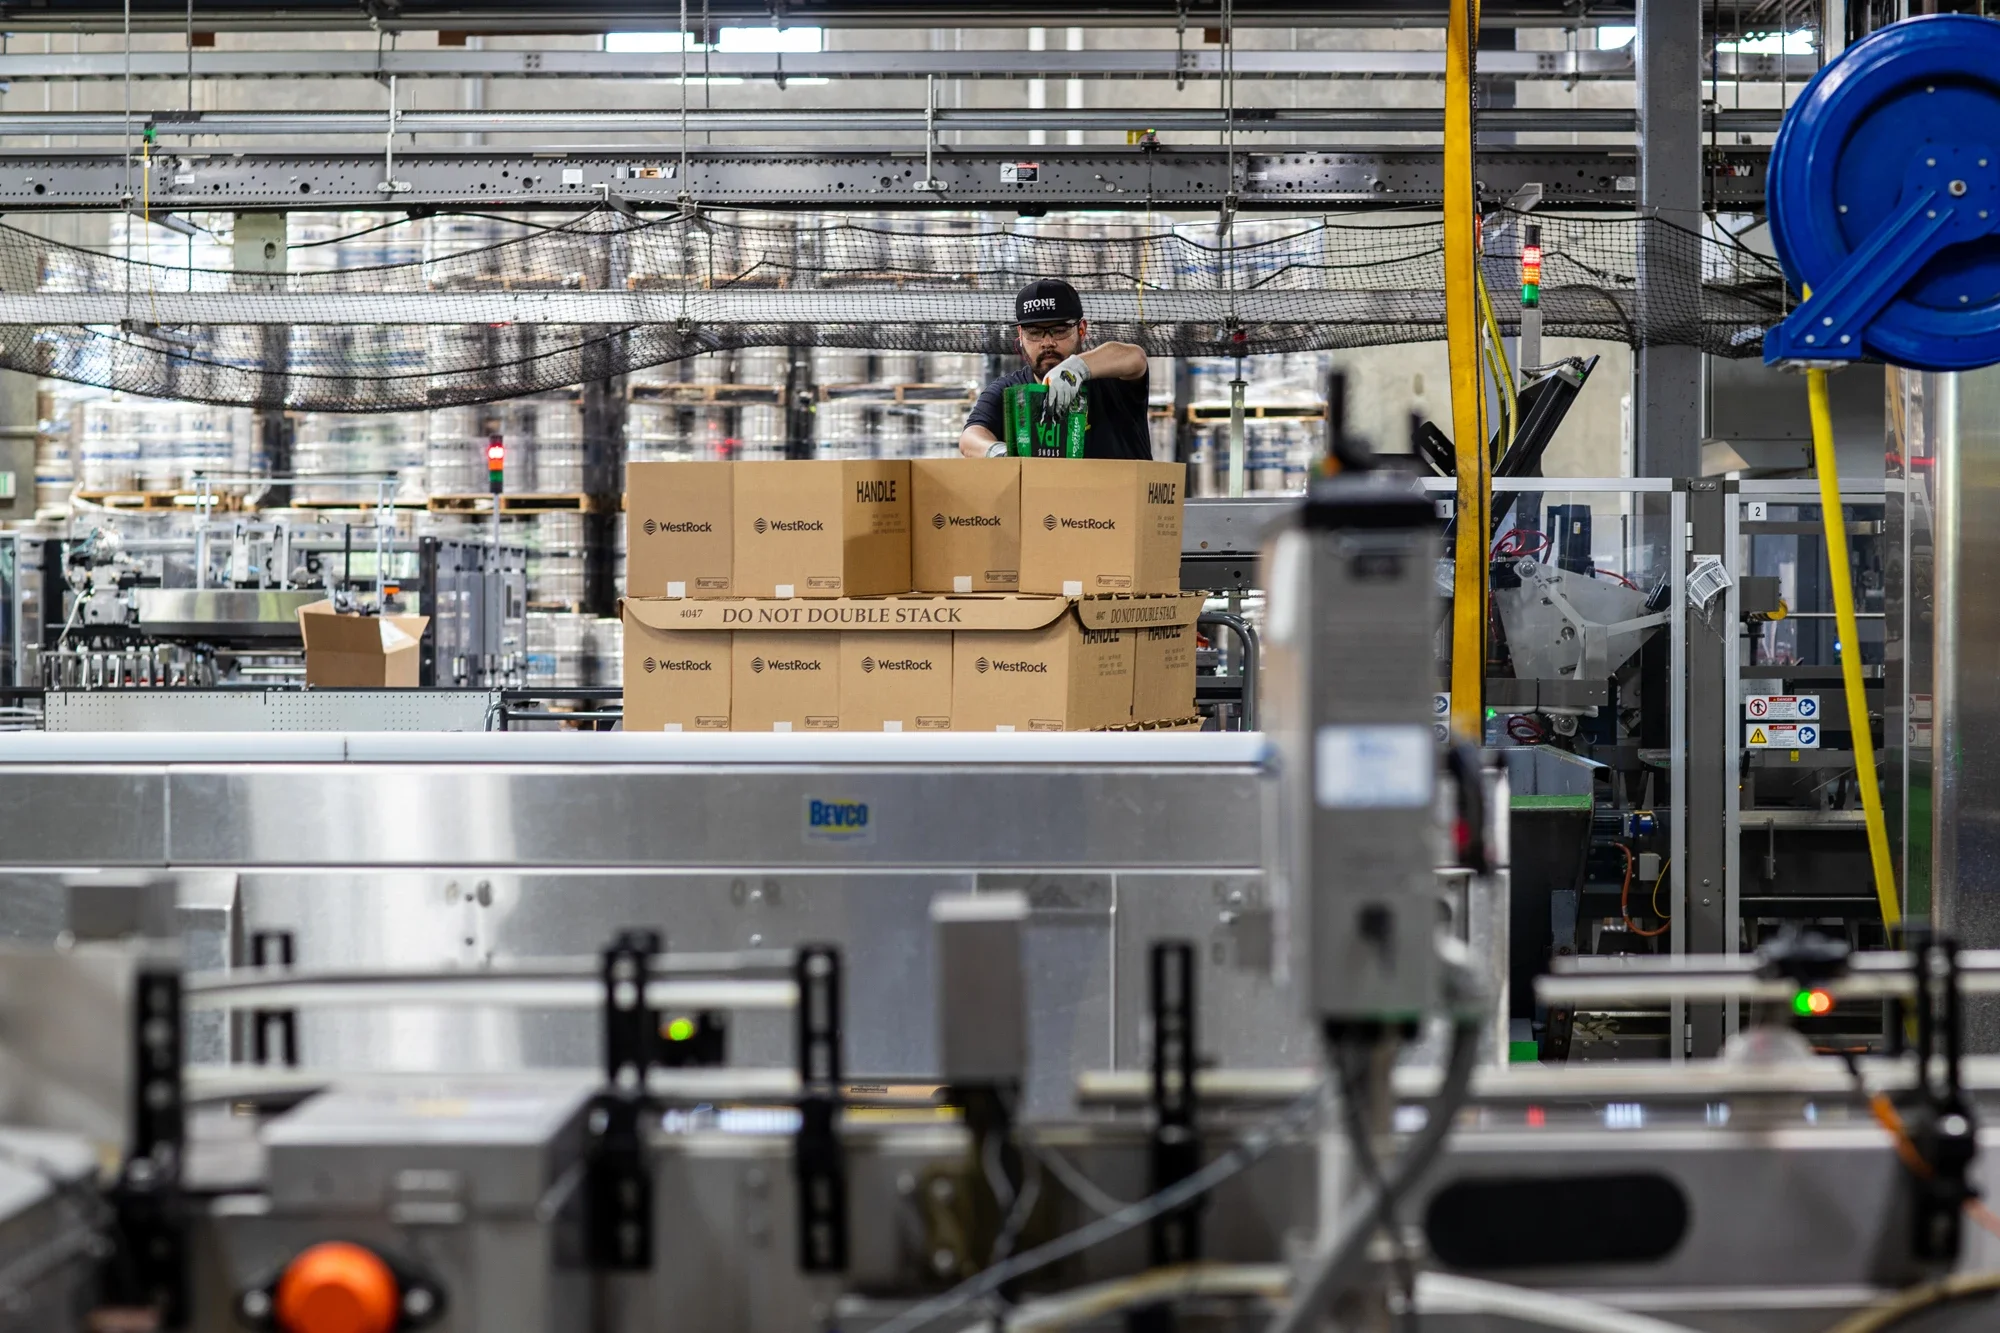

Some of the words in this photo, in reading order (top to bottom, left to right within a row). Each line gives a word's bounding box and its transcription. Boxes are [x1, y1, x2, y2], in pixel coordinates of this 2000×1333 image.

[630, 167, 674, 179] TGW
[1023, 298, 1056, 310] STONE
[1036, 423, 1060, 447] IPA
[857, 480, 896, 503] HANDLE
[1147, 482, 1176, 505] HANDLE
[1442, 503, 1447, 514] 1
[1755, 506, 1761, 517] 2
[660, 521, 712, 533] WestRock
[771, 520, 823, 531] WestRock
[949, 516, 1001, 527] WestRock
[1060, 518, 1116, 530] WestRock
[680, 609, 703, 618] 4047
[722, 608, 753, 623] DO
[757, 608, 802, 623] NOT
[807, 608, 890, 623] DOUBLE
[896, 607, 963, 623] STACK
[1110, 608, 1122, 623] DO
[1121, 607, 1135, 623] NOT
[1135, 606, 1159, 623] DOUBLE
[1158, 605, 1177, 621] STACK
[1082, 628, 1120, 645] HANDLE
[1147, 625, 1181, 641] HANDLE
[659, 660, 712, 671] WestRock
[768, 660, 821, 671] WestRock
[878, 659, 932, 671] WestRock
[993, 660, 1047, 673] WestRock
